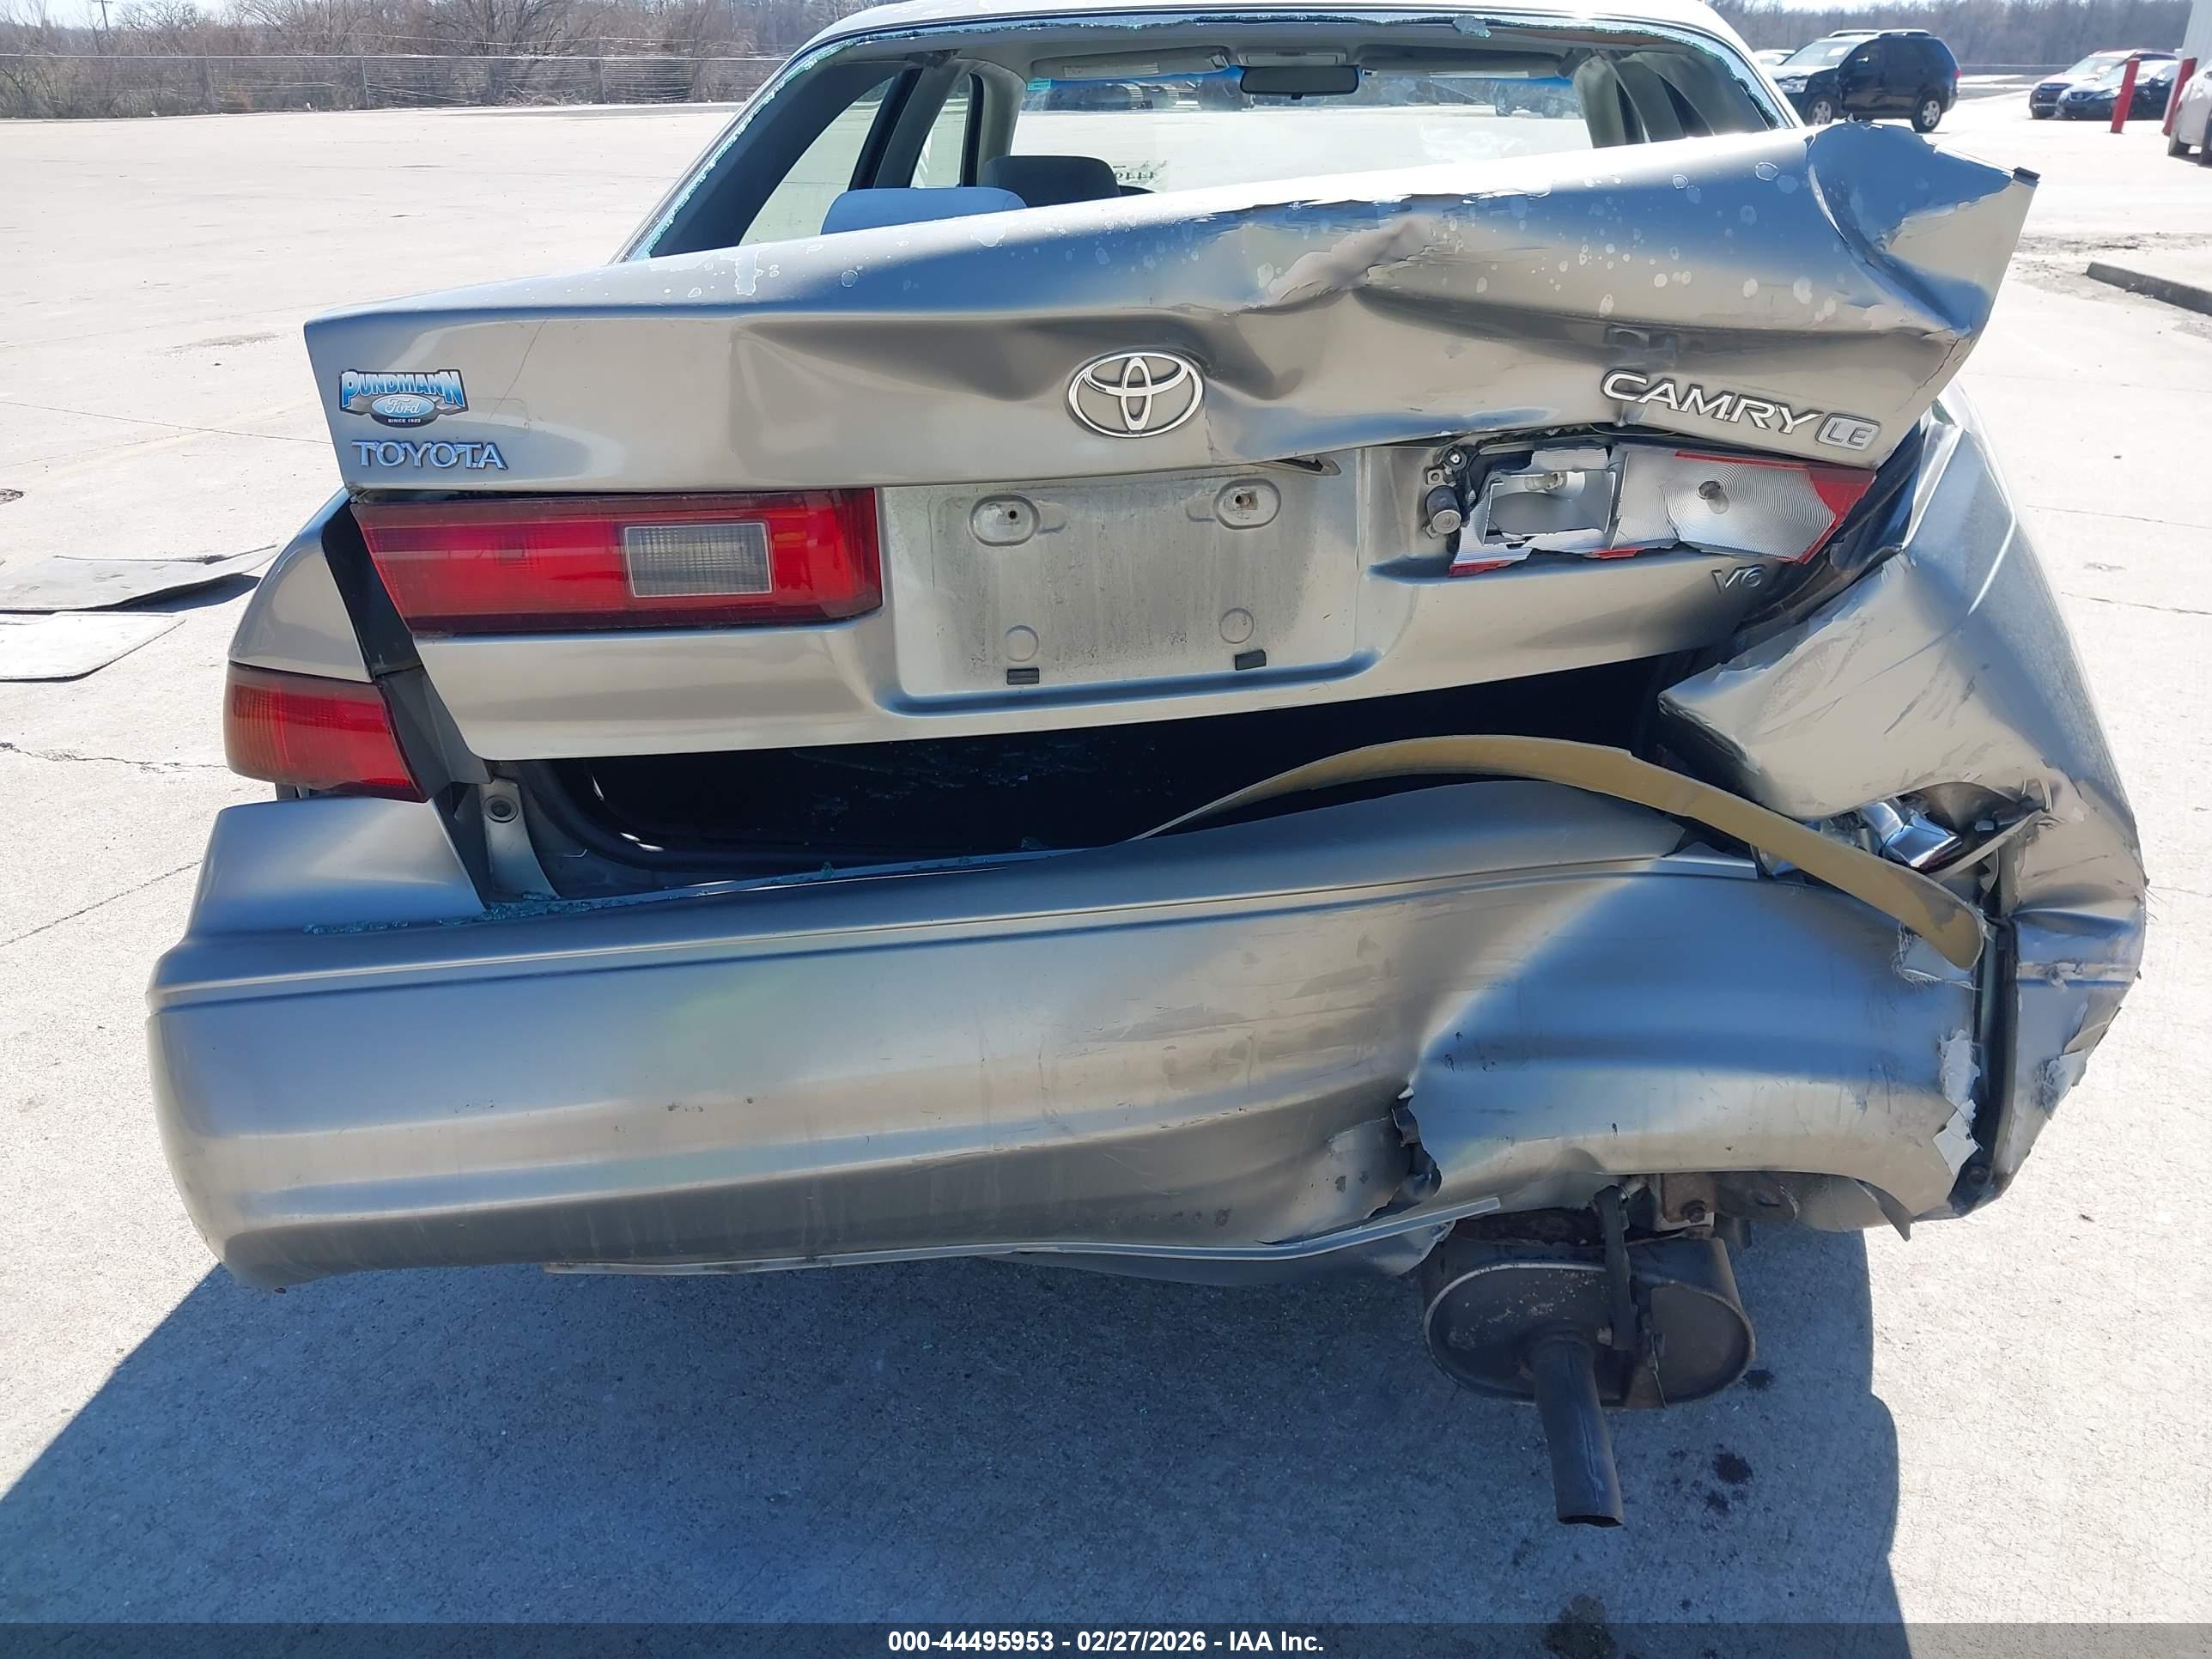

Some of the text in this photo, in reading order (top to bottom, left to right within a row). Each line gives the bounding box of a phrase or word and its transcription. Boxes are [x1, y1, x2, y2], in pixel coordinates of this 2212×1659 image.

[341, 370, 465, 409] PUNDMANN
[385, 398, 422, 414] Ford
[1601, 369, 1873, 447] CAMRY LE
[352, 440, 508, 471] TOYOTA
[1711, 563, 1766, 593] V6
